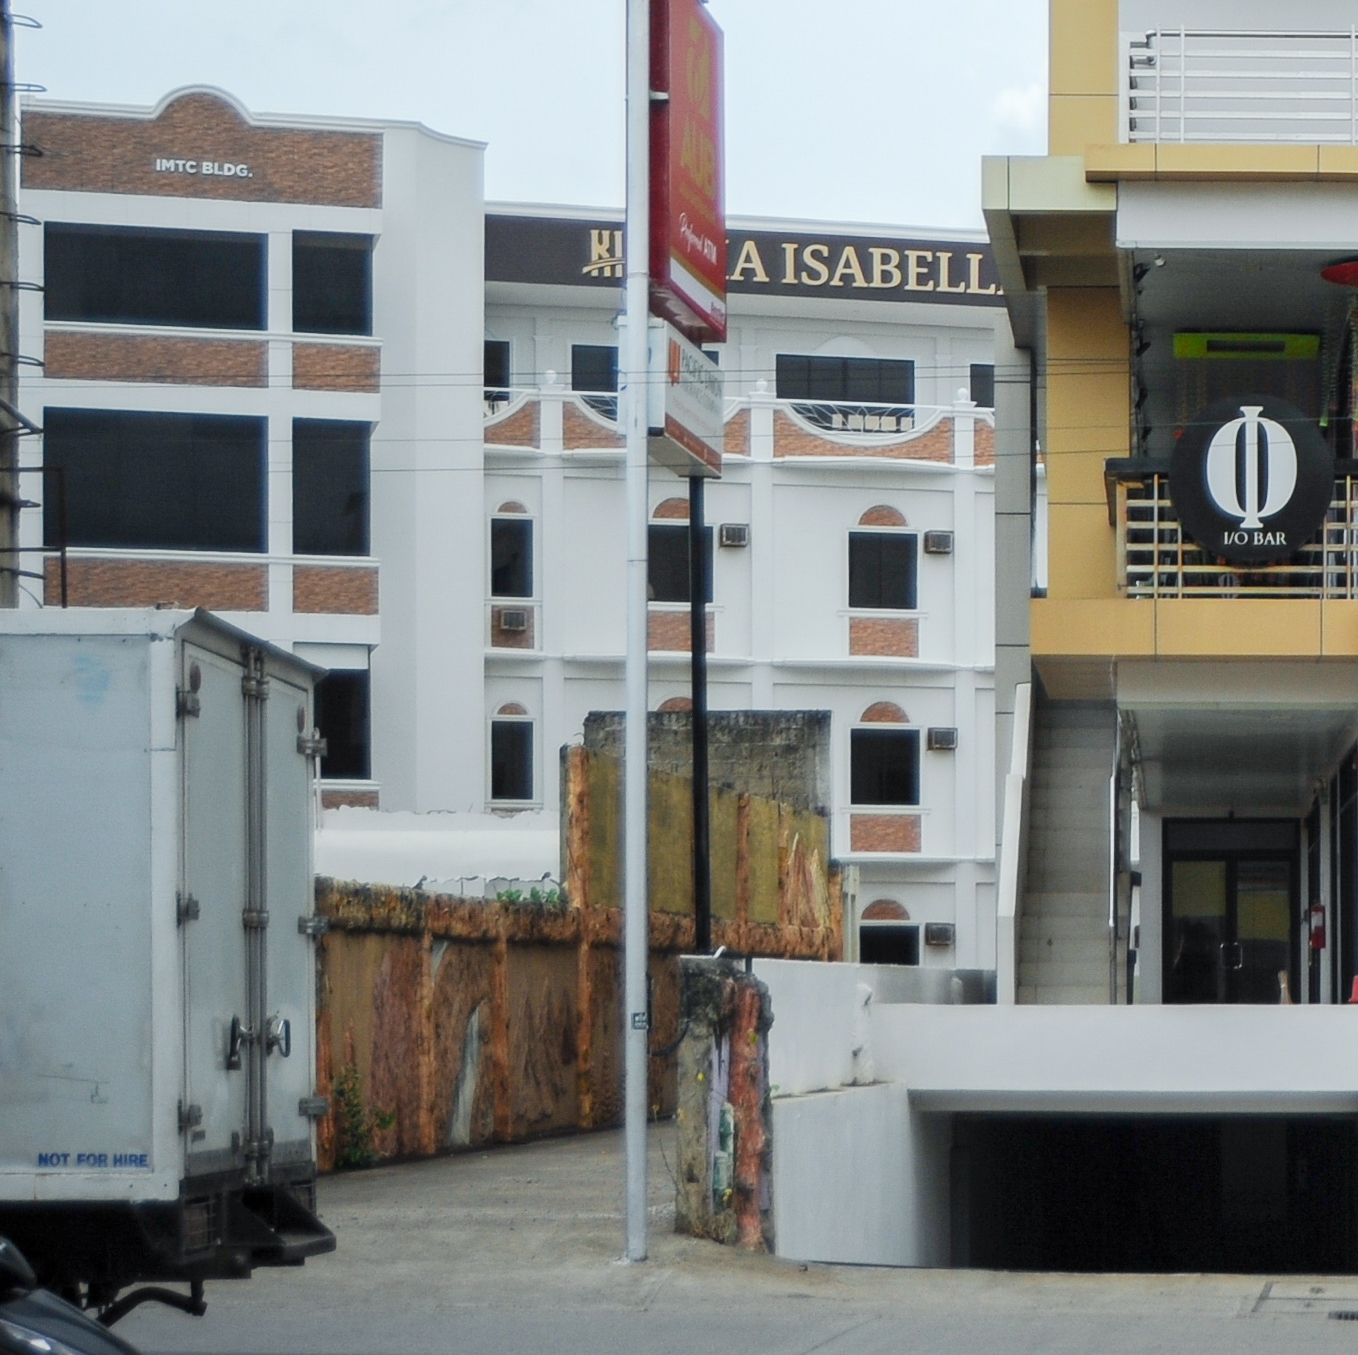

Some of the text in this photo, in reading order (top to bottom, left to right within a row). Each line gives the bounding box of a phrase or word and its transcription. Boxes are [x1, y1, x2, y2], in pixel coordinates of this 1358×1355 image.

[156, 158, 253, 178] IMTC BLDG.
[781, 243, 1003, 296] ISABELL
[1223, 531, 1287, 545] I/O BAR
[38, 1153, 149, 1168] NOT FOR HIRE
